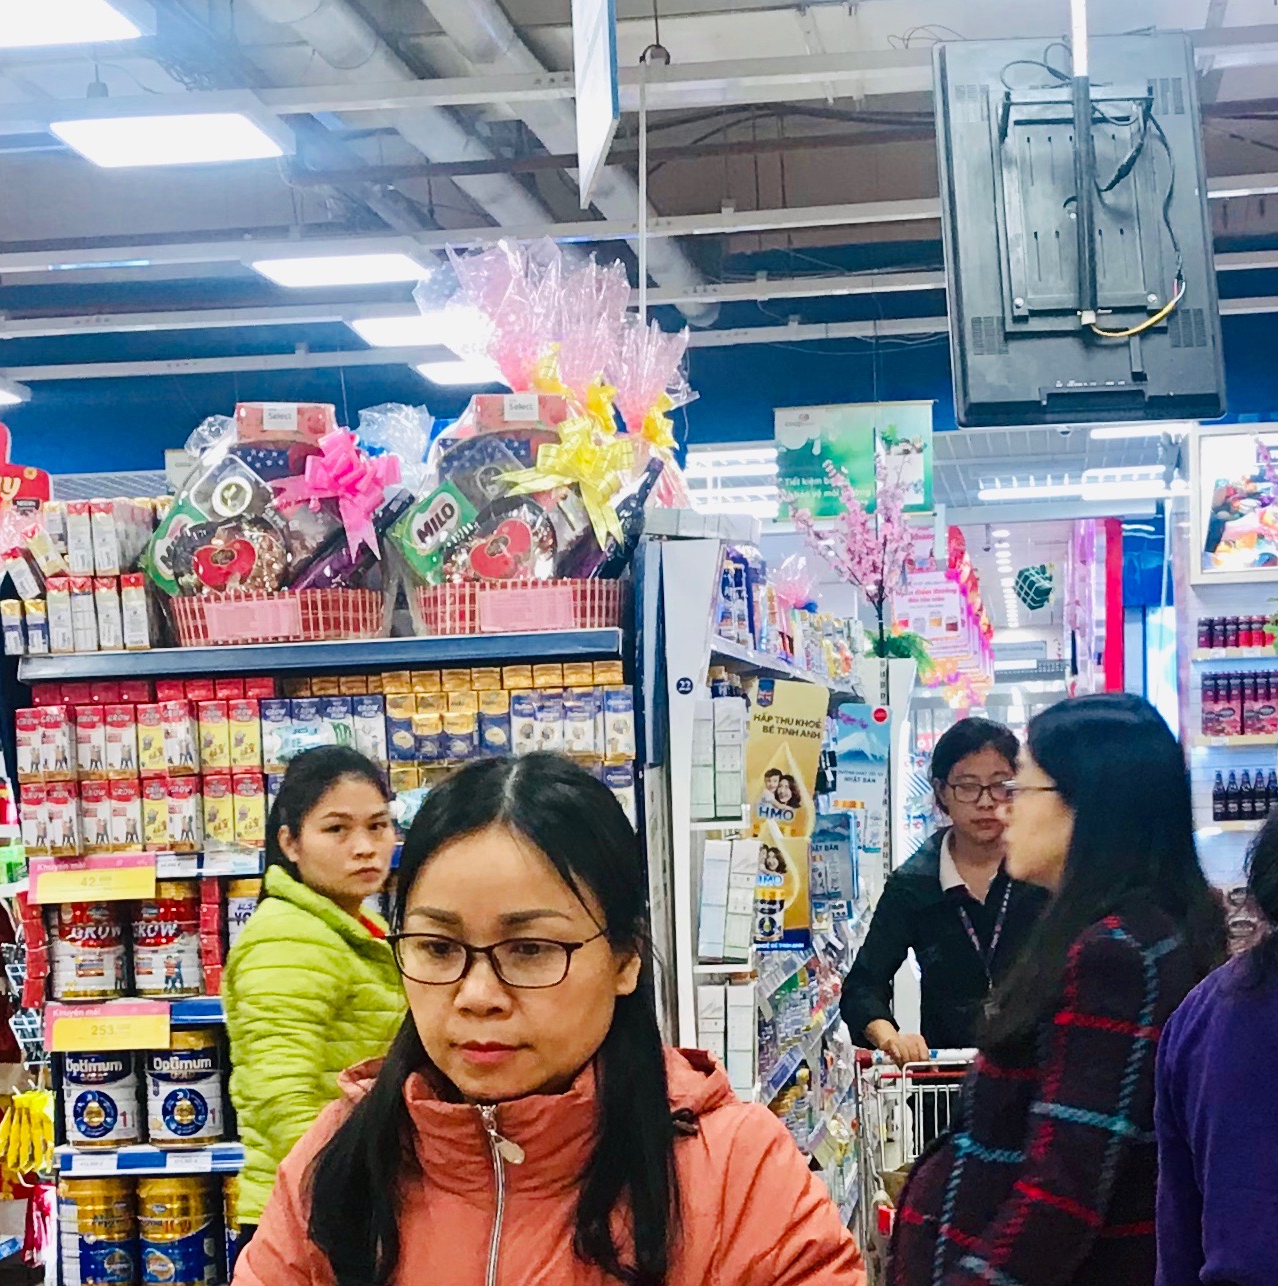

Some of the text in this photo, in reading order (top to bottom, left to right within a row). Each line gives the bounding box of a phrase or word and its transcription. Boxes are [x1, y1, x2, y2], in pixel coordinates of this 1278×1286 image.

[416, 502, 456, 544] MILO
[679, 680, 692, 691] 22
[776, 716, 793, 726] THU
[778, 727, 800, 737] TINH
[801, 730, 821, 740] ANH
[758, 806, 794, 821] HMO
[65, 1059, 123, 1073] Optimum
[153, 1056, 212, 1071] Optimum
